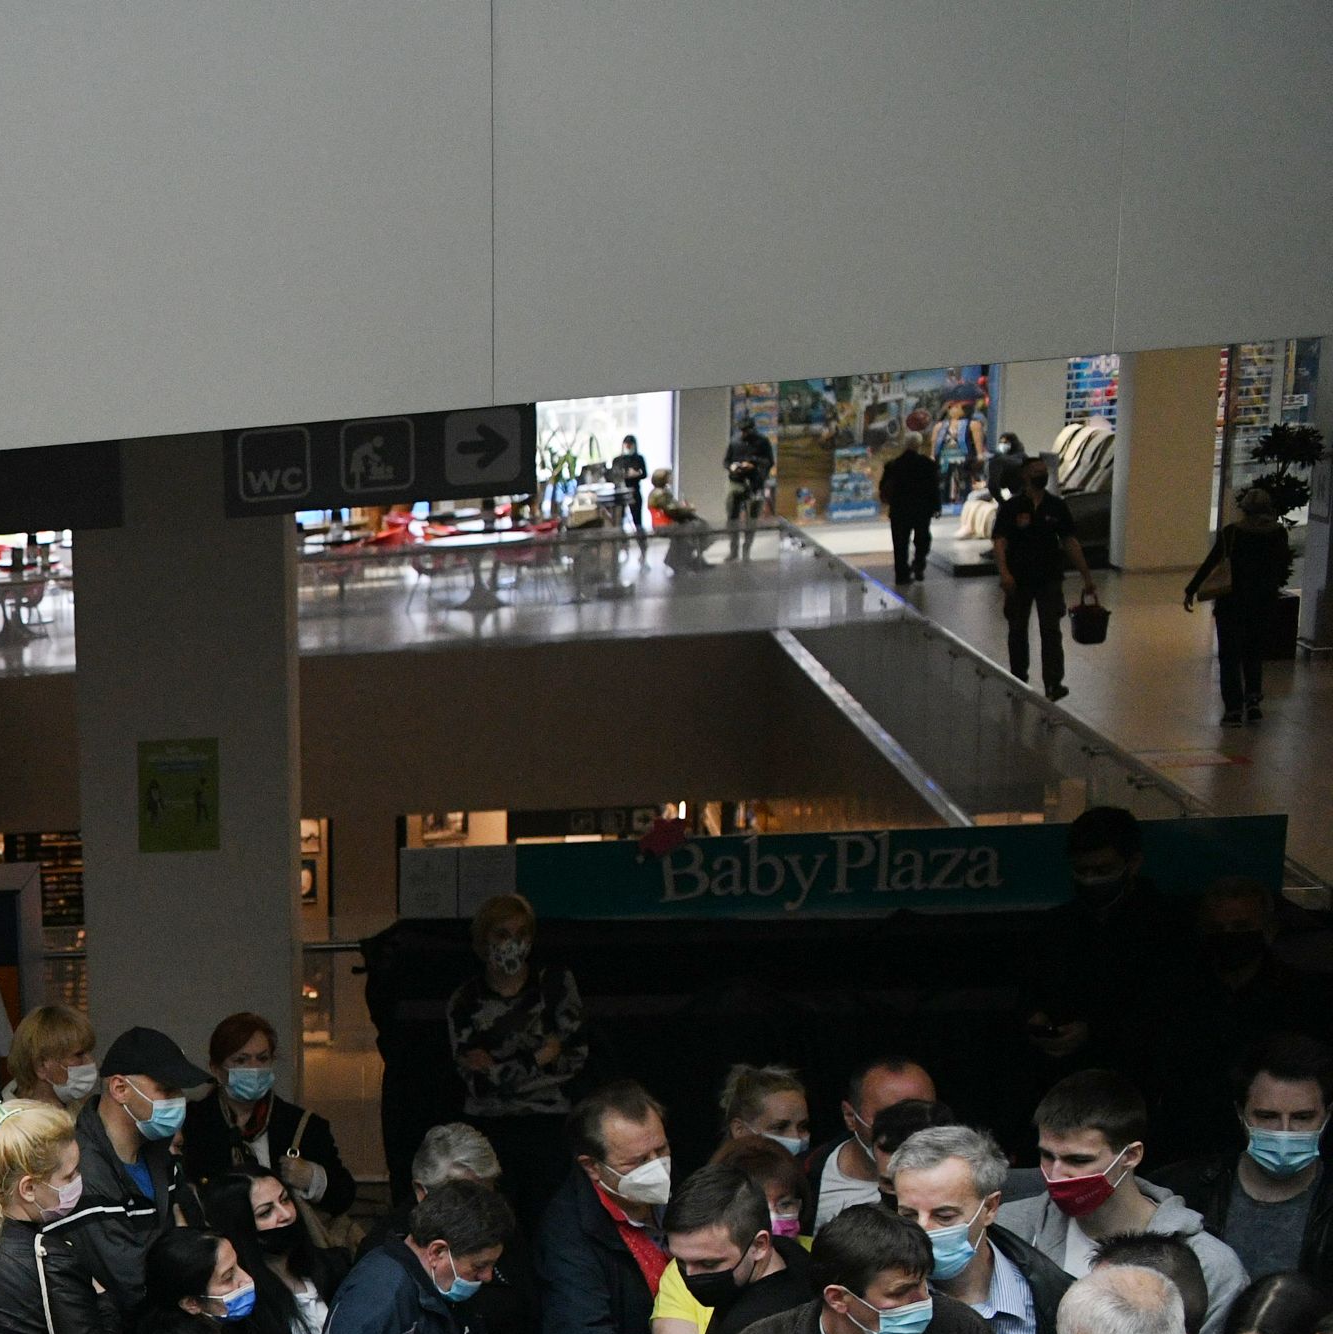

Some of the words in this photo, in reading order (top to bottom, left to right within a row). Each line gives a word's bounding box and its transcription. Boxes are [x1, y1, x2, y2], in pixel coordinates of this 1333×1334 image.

[246, 466, 304, 495] WC
[660, 832, 828, 912] Baby
[829, 830, 1005, 894] Plaza
